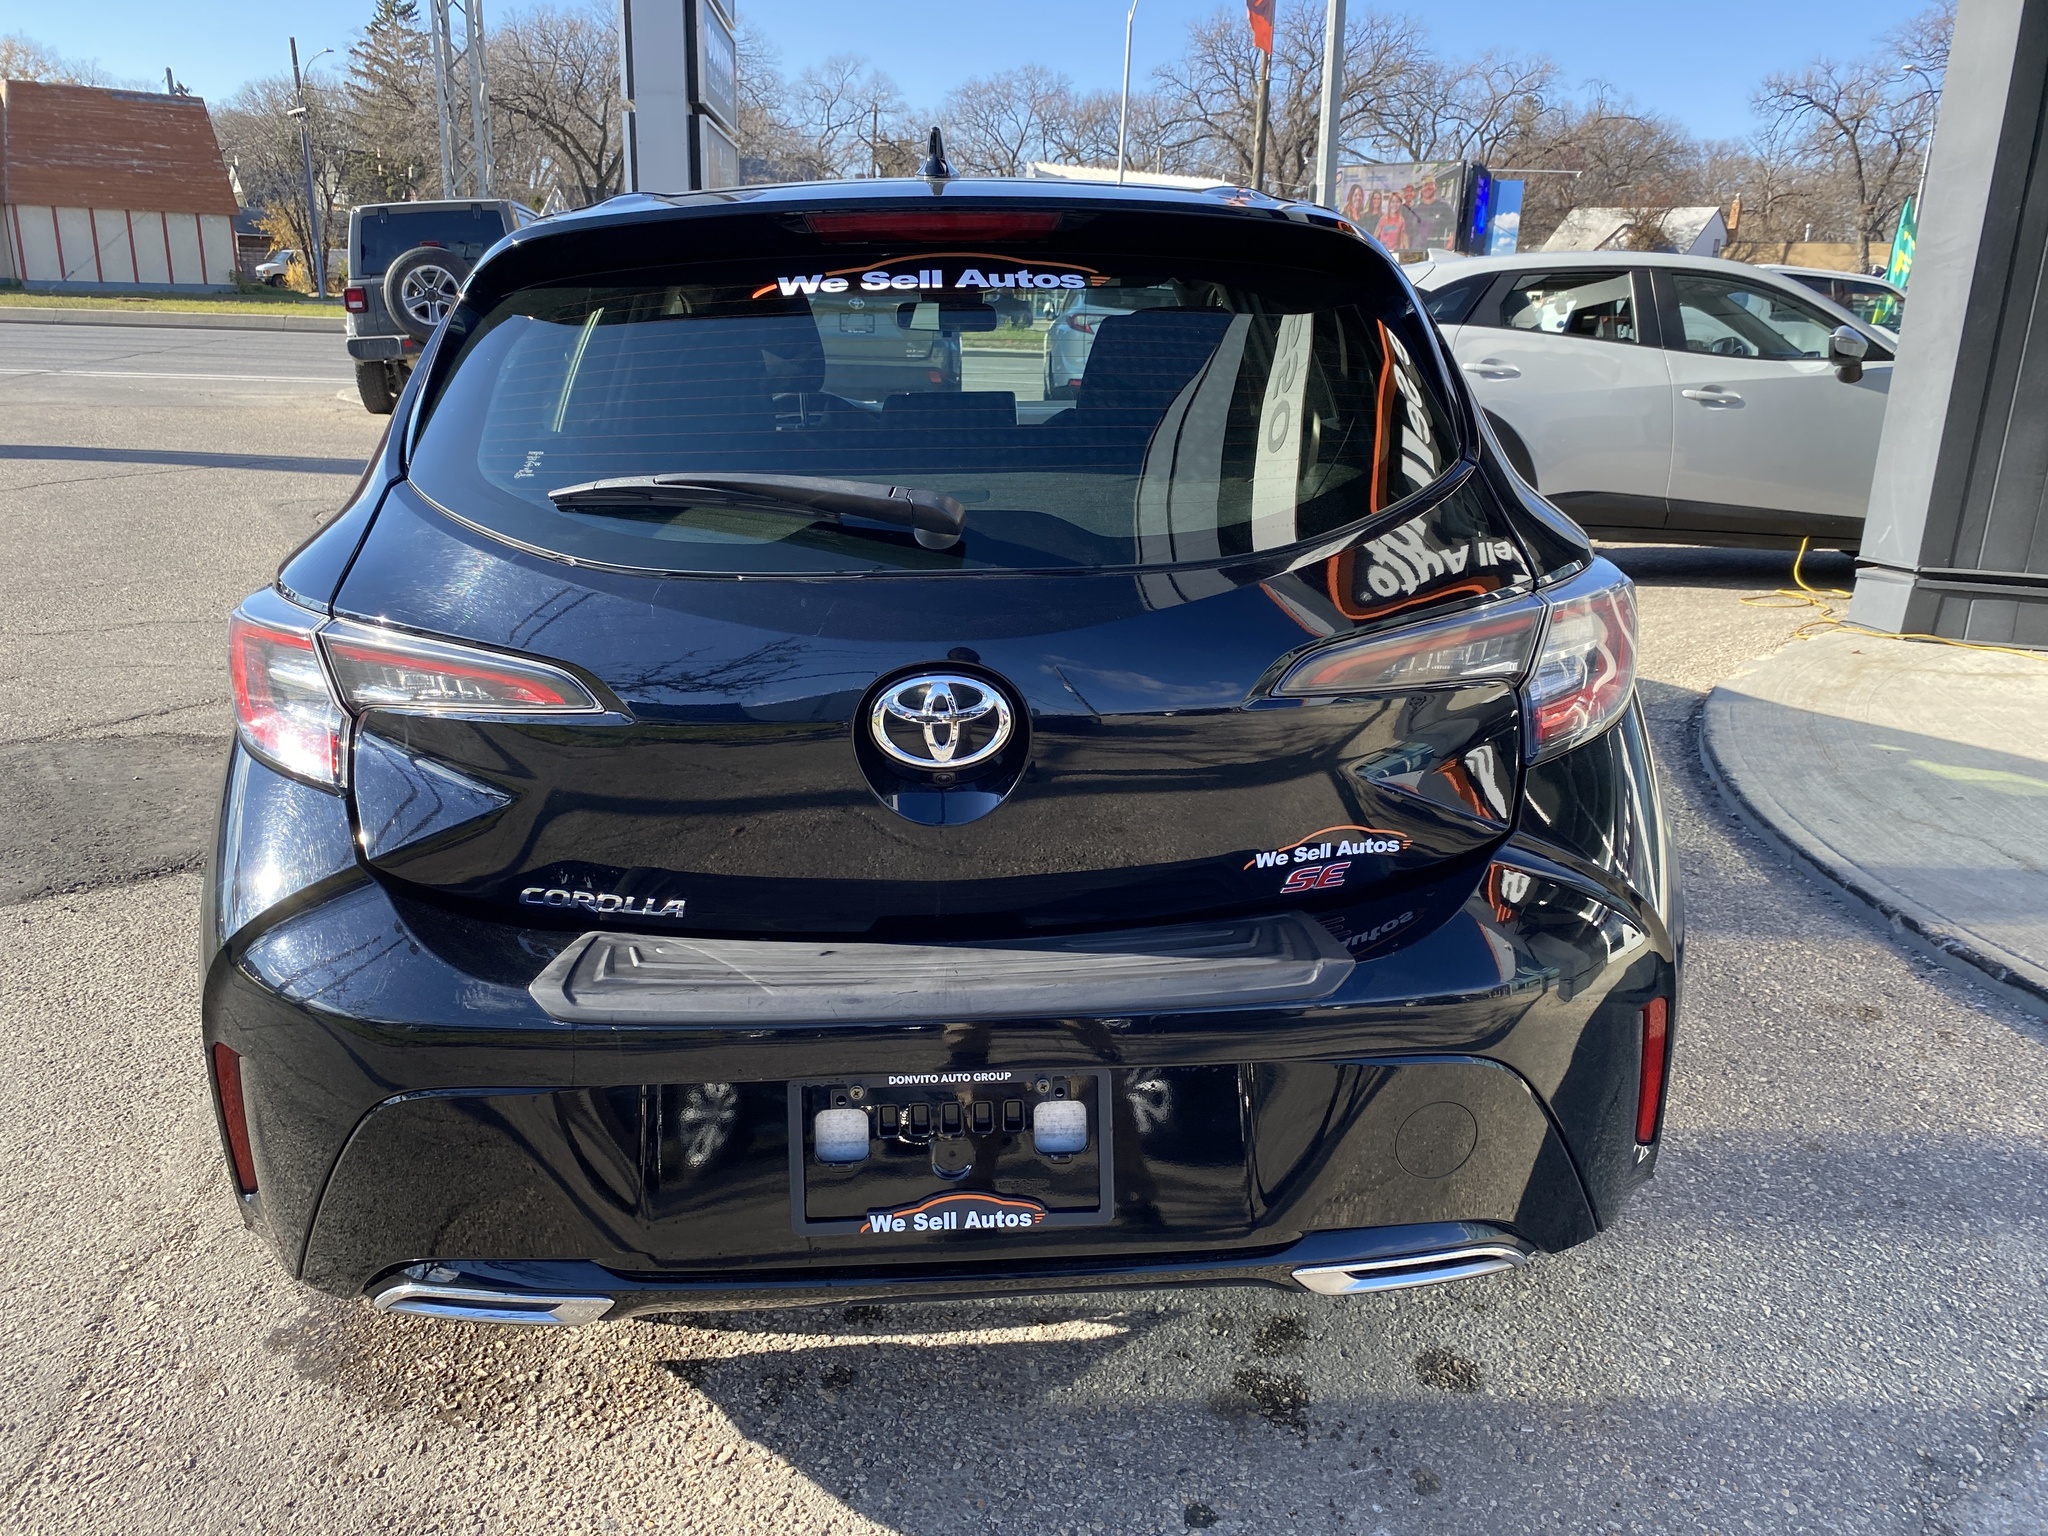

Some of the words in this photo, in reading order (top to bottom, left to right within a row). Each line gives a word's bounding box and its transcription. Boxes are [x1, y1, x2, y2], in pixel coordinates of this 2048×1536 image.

[777, 274, 850, 296] We
[860, 269, 943, 291] Sell
[954, 269, 1086, 290] Autos
[1255, 851, 1289, 869] We
[1293, 842, 1332, 863] Sell
[1336, 838, 1399, 857] Autos
[1279, 861, 1352, 894] SE
[518, 887, 687, 918] COROLLA
[888, 1075, 939, 1085] DONVITO
[941, 1073, 971, 1083] AUTO
[973, 1072, 1012, 1082] GROUP
[869, 1214, 906, 1233] We
[913, 1211, 957, 1231] Sell
[964, 1210, 1033, 1229] Autos
